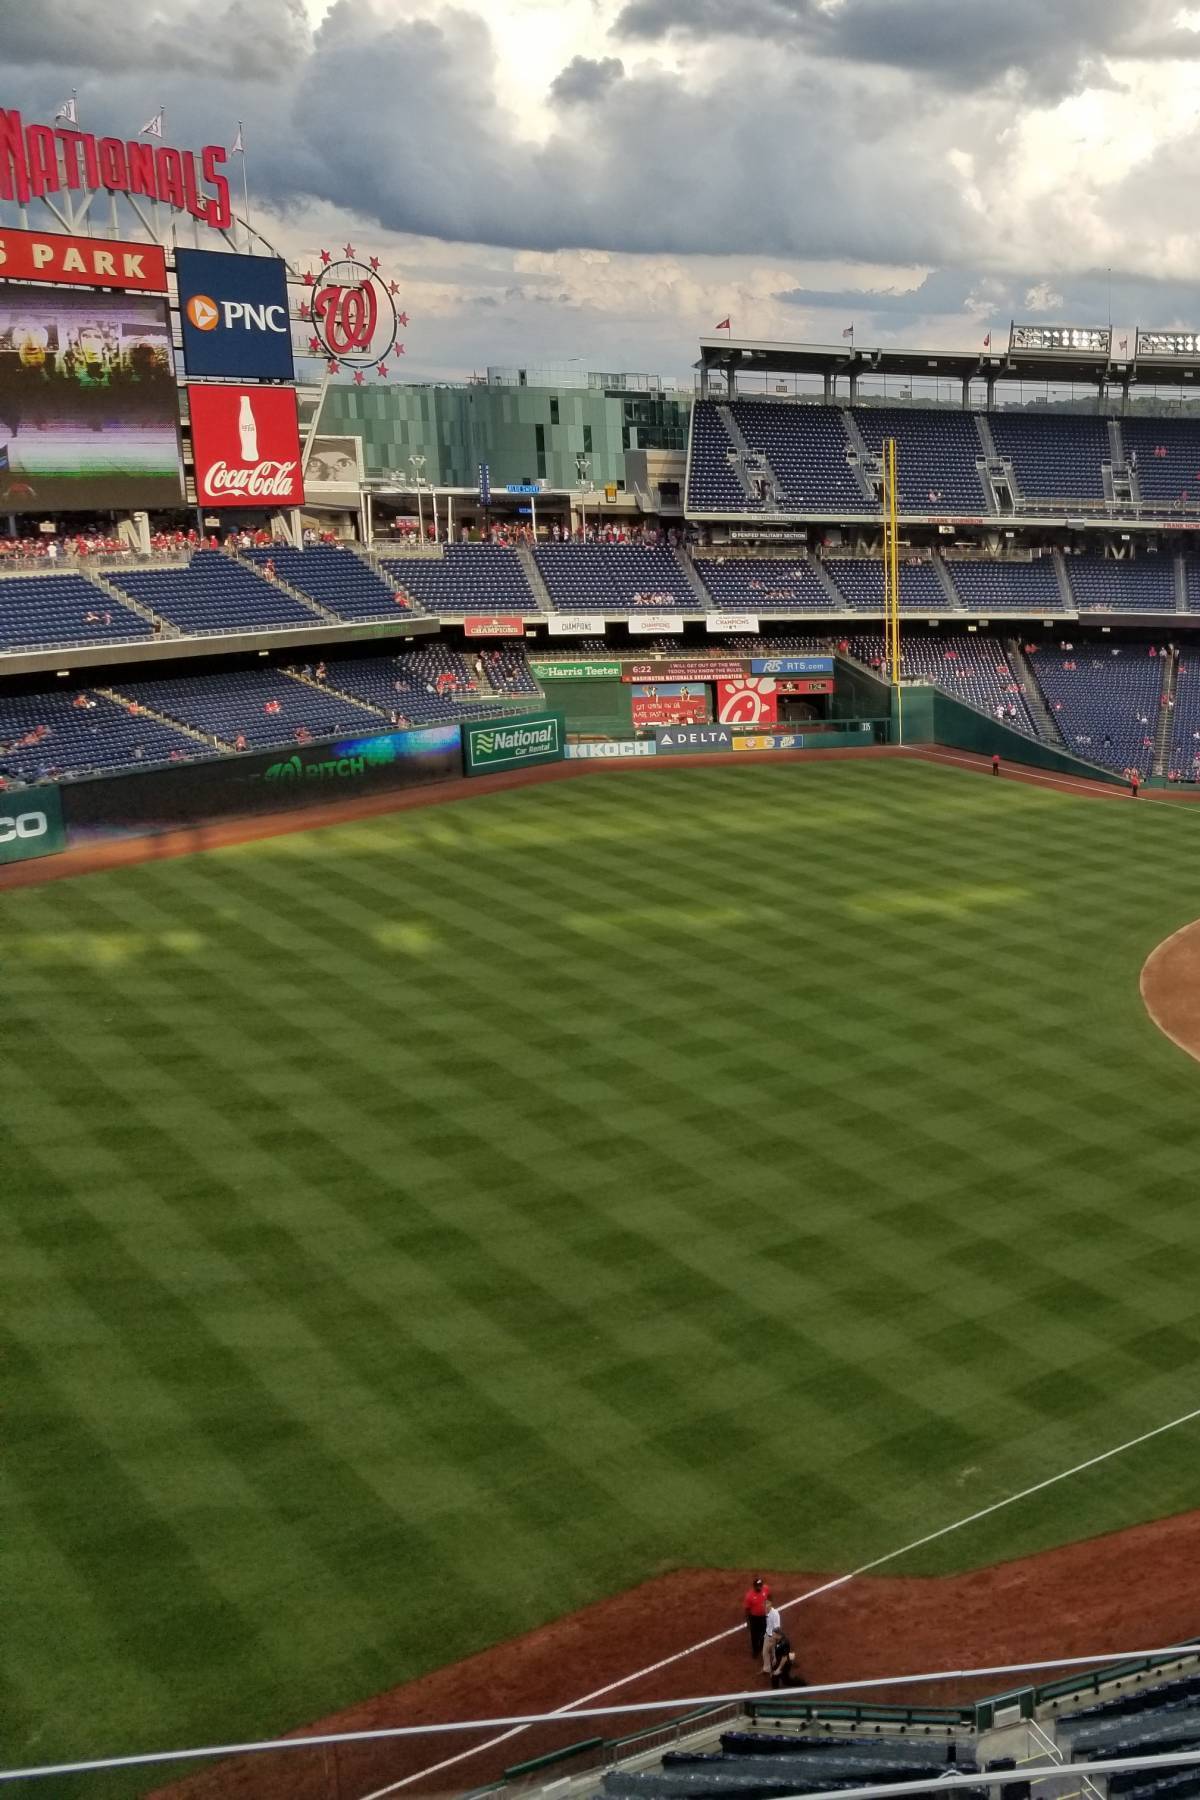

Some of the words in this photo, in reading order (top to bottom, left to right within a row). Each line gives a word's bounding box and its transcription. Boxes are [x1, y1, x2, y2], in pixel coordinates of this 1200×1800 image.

[0, 107, 231, 229] NATIONALS
[32, 243, 147, 279] PARK
[221, 300, 287, 333] PNC
[204, 461, 297, 496] Coca-Cola
[471, 626, 518, 634] CHAMPIONS
[561, 622, 592, 632] CHAMPIONS
[548, 666, 582, 676] Harris
[584, 666, 619, 675] Teeter
[632, 665, 652, 673] 6:22
[787, 662, 824, 670] RTS.com
[494, 725, 552, 750] National
[677, 731, 728, 744] DELTA
[515, 748, 528, 756] Car
[529, 743, 550, 753] Rental
[589, 741, 649, 757] KOCH
